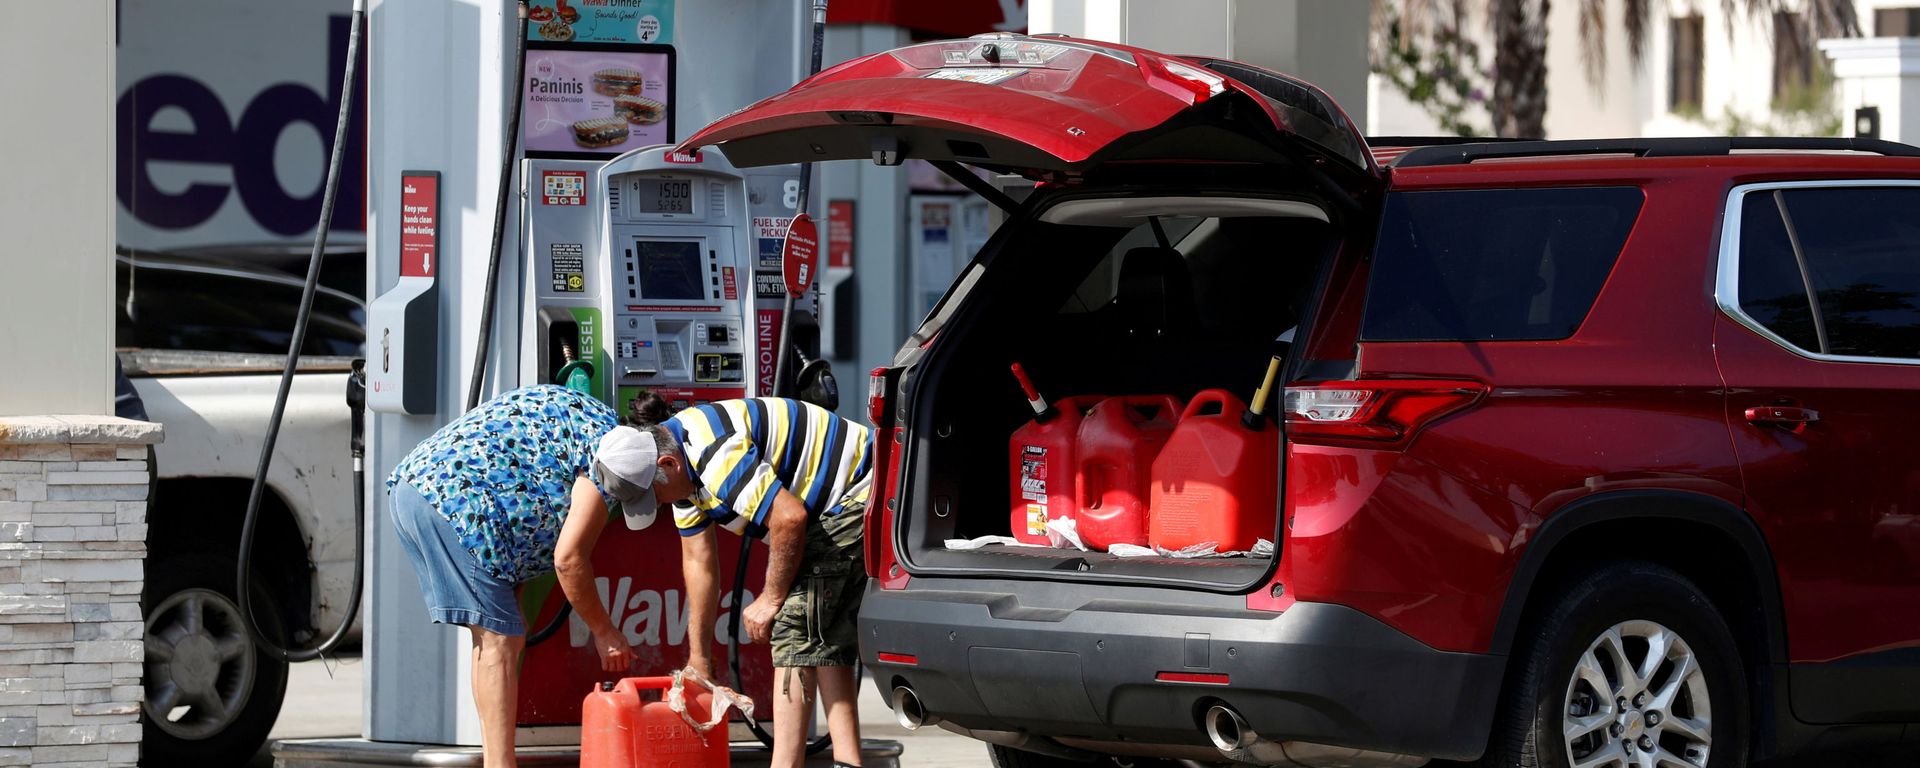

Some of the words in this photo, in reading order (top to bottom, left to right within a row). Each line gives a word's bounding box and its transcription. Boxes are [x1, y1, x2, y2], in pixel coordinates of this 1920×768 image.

[642, 31, 648, 41] 4
[530, 77, 583, 95] Paninis
[116, 14, 367, 237] ed
[673, 152, 696, 163] Wawa
[633, 182, 639, 191] $
[783, 179, 800, 209] 8
[404, 204, 417, 214] Keep
[417, 206, 429, 214] your
[404, 214, 418, 223] hands
[419, 215, 432, 224] clean
[753, 218, 774, 227] FUEL
[776, 219, 791, 228] SID
[403, 226, 417, 235] while
[761, 228, 788, 238] PICKU
[757, 284, 771, 293] 10%
[771, 284, 786, 294] ETH
[581, 315, 594, 360] IESEL
[647, 724, 700, 740] ESSEN
